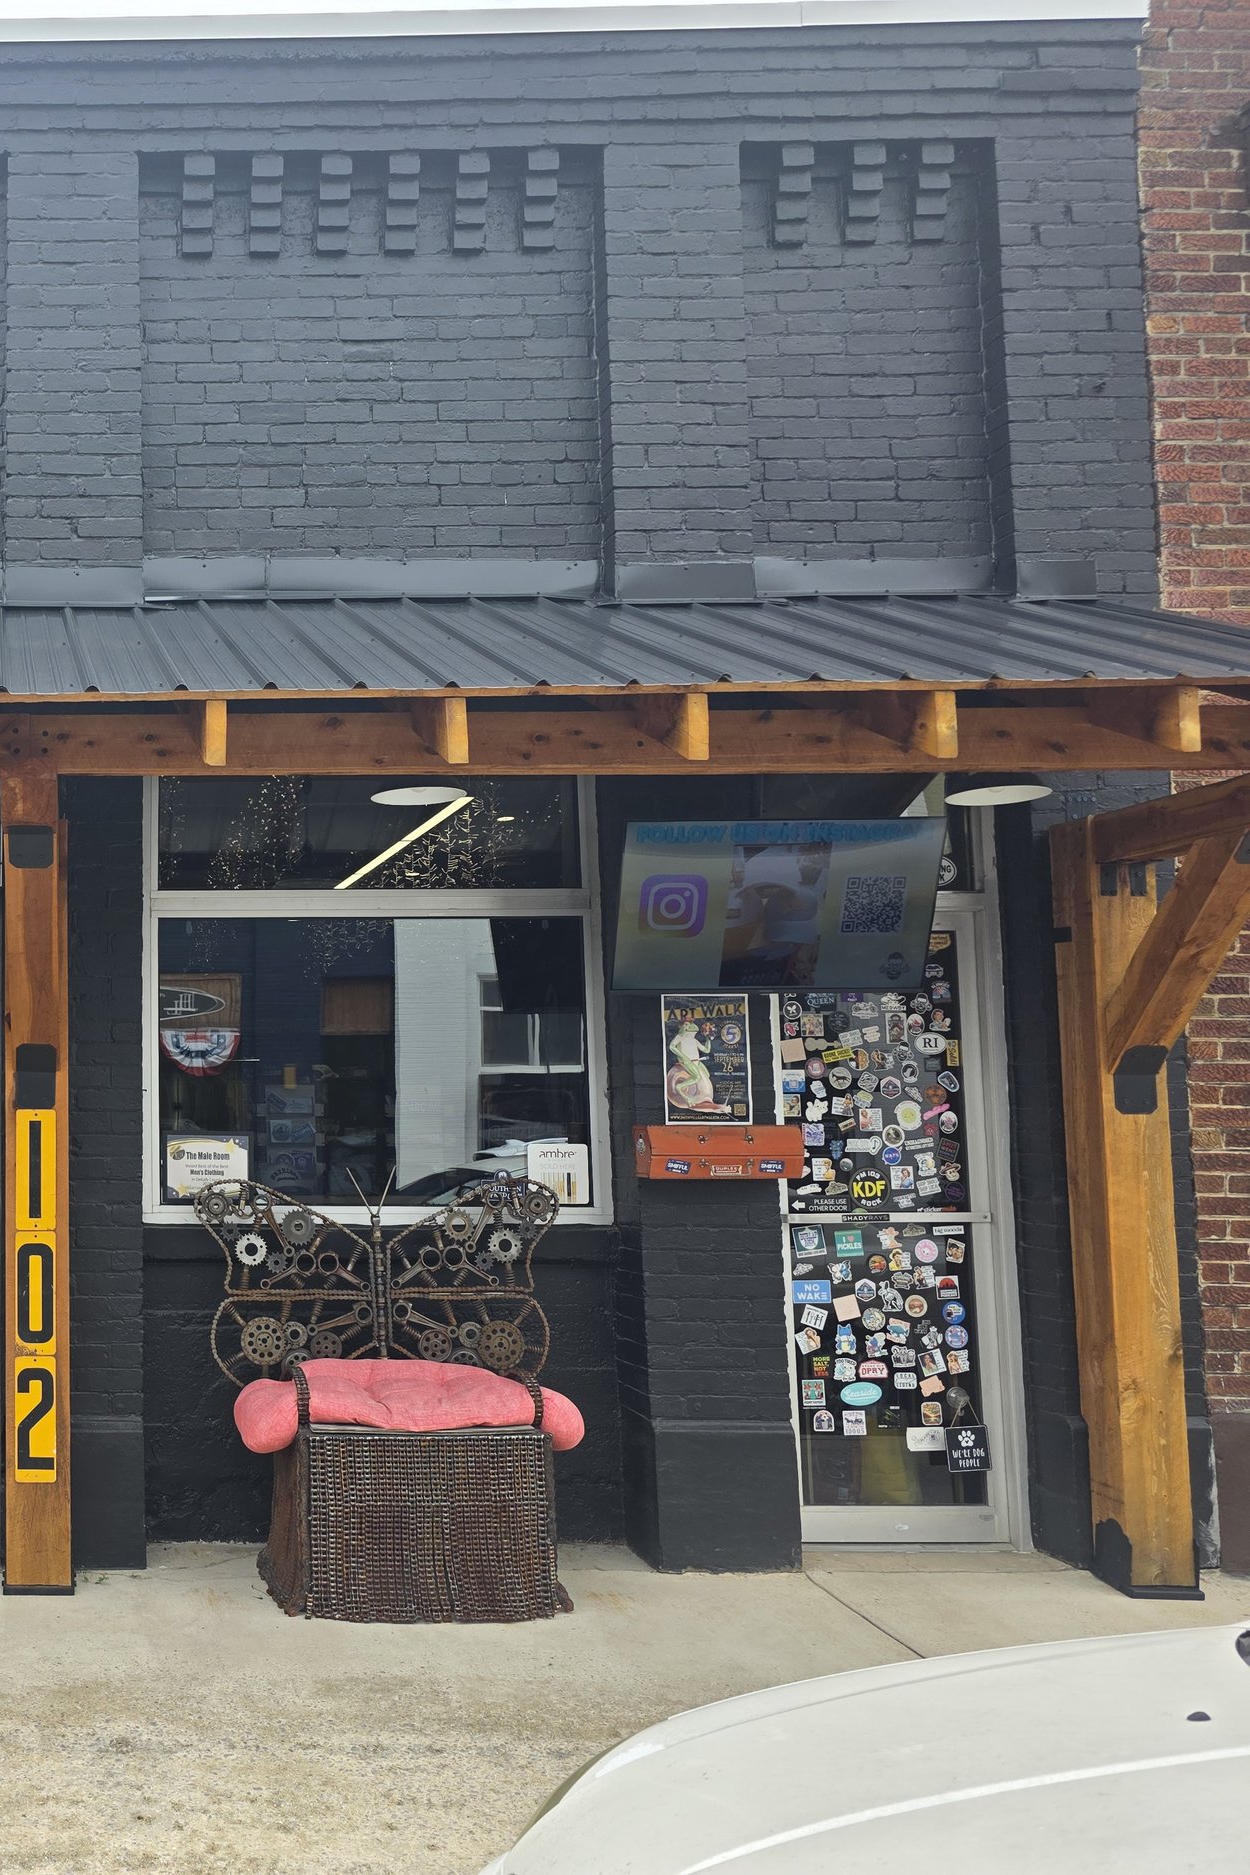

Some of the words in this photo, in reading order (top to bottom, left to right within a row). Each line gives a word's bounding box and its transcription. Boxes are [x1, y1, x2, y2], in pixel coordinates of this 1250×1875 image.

[636, 824, 727, 844] FOLLOW
[802, 820, 935, 841] INSTAGRAM
[806, 997, 836, 1008] QUEEN
[666, 1005, 697, 1023] ART
[699, 1002, 742, 1018] WALK
[923, 1037, 939, 1049] RI
[722, 1062, 734, 1073] 26
[186, 1151, 197, 1160] The
[197, 1151, 212, 1160] Male
[213, 1151, 230, 1160] Room
[539, 1148, 575, 1159] ambre
[855, 1173, 866, 1181] FM
[867, 1170, 881, 1180] 103
[852, 1180, 886, 1198] KDF
[860, 1197, 882, 1207] ROCK
[837, 1242, 863, 1250] PICKLES
[804, 1283, 820, 1291] NO
[796, 1292, 828, 1301] WAKE
[861, 1367, 885, 1375] OPRY
[844, 1388, 877, 1398] Seaside
[952, 1449, 972, 1458] WE'RE
[972, 1448, 985, 1457] DOG
[958, 1458, 980, 1468] PEOPLE
